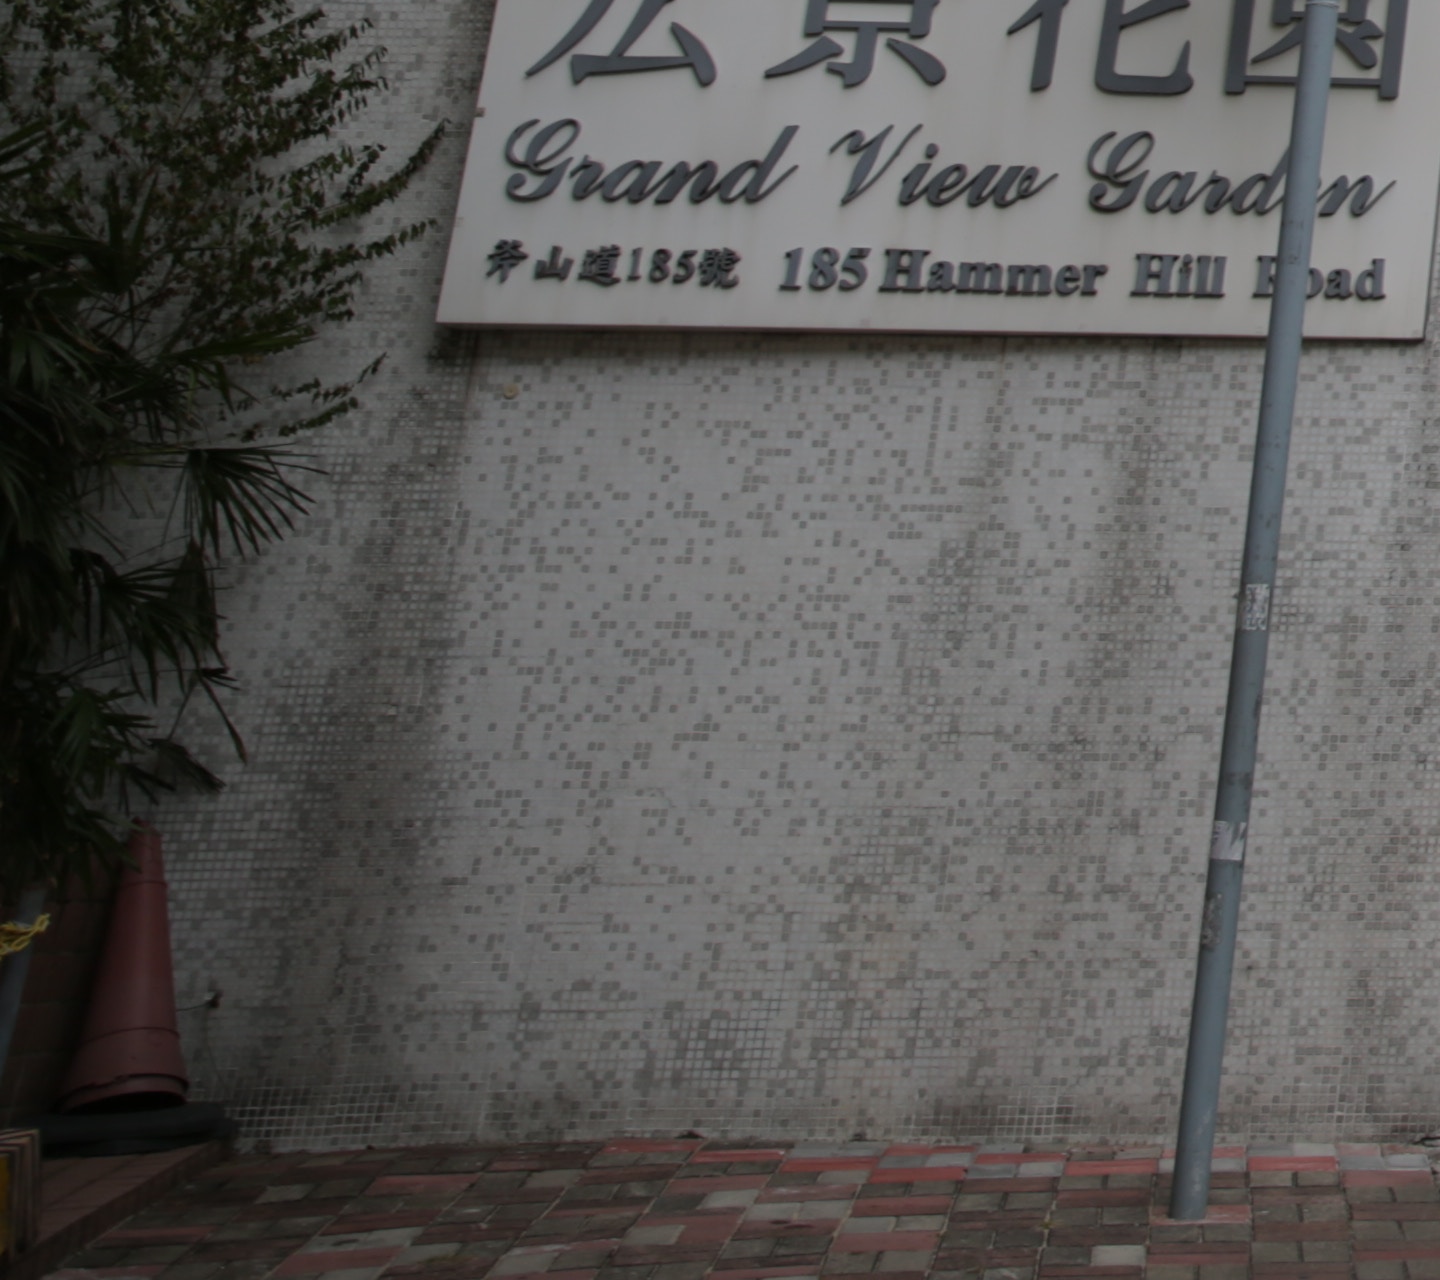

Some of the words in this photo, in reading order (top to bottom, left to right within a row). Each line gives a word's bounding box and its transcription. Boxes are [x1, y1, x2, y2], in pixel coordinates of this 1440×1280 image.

[503, 116, 800, 207] Grand
[830, 123, 1058, 209] View
[1087, 130, 1398, 218] Gardn
[778, 246, 868, 292] 185
[878, 249, 1109, 298] Hammer
[1130, 253, 1228, 299] Hill
